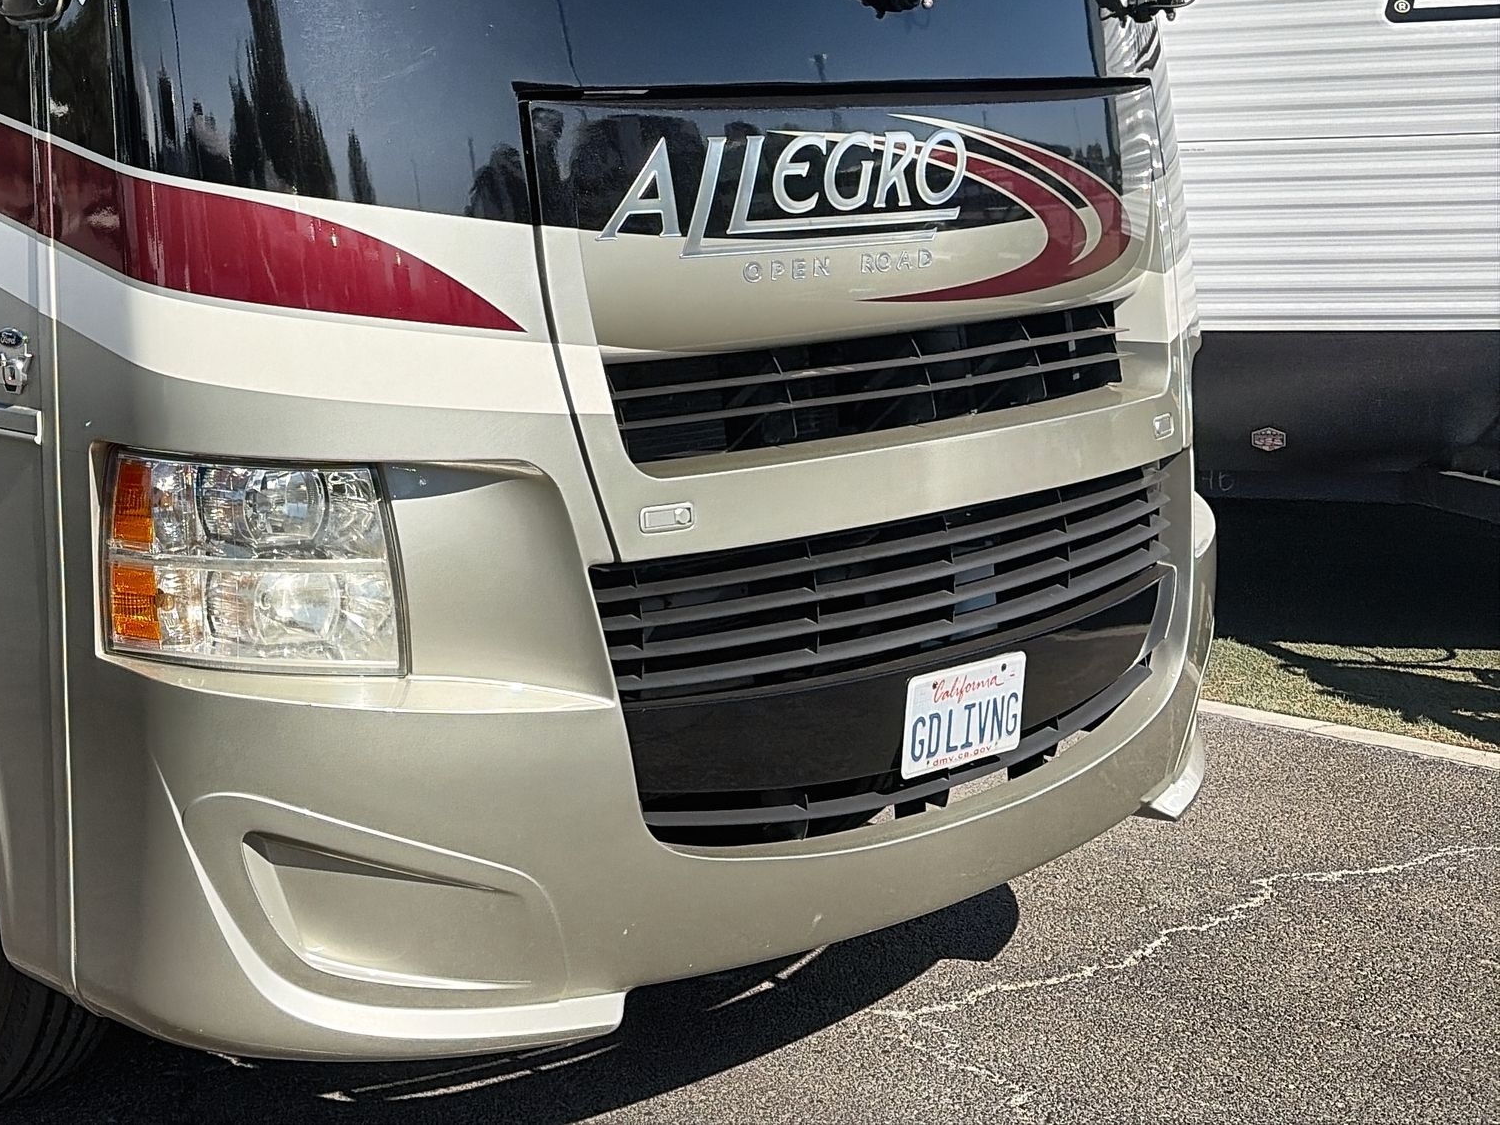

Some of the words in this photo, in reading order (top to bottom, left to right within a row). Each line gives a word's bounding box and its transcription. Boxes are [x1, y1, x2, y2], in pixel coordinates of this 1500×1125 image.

[595, 129, 968, 259] ALLEGRO
[743, 256, 831, 284] OPEN
[860, 248, 934, 274] ROAD
[933, 675, 1005, 704] California
[910, 692, 1019, 763] GDLIVNG
[932, 745, 992, 767] dmv.ca.gov
